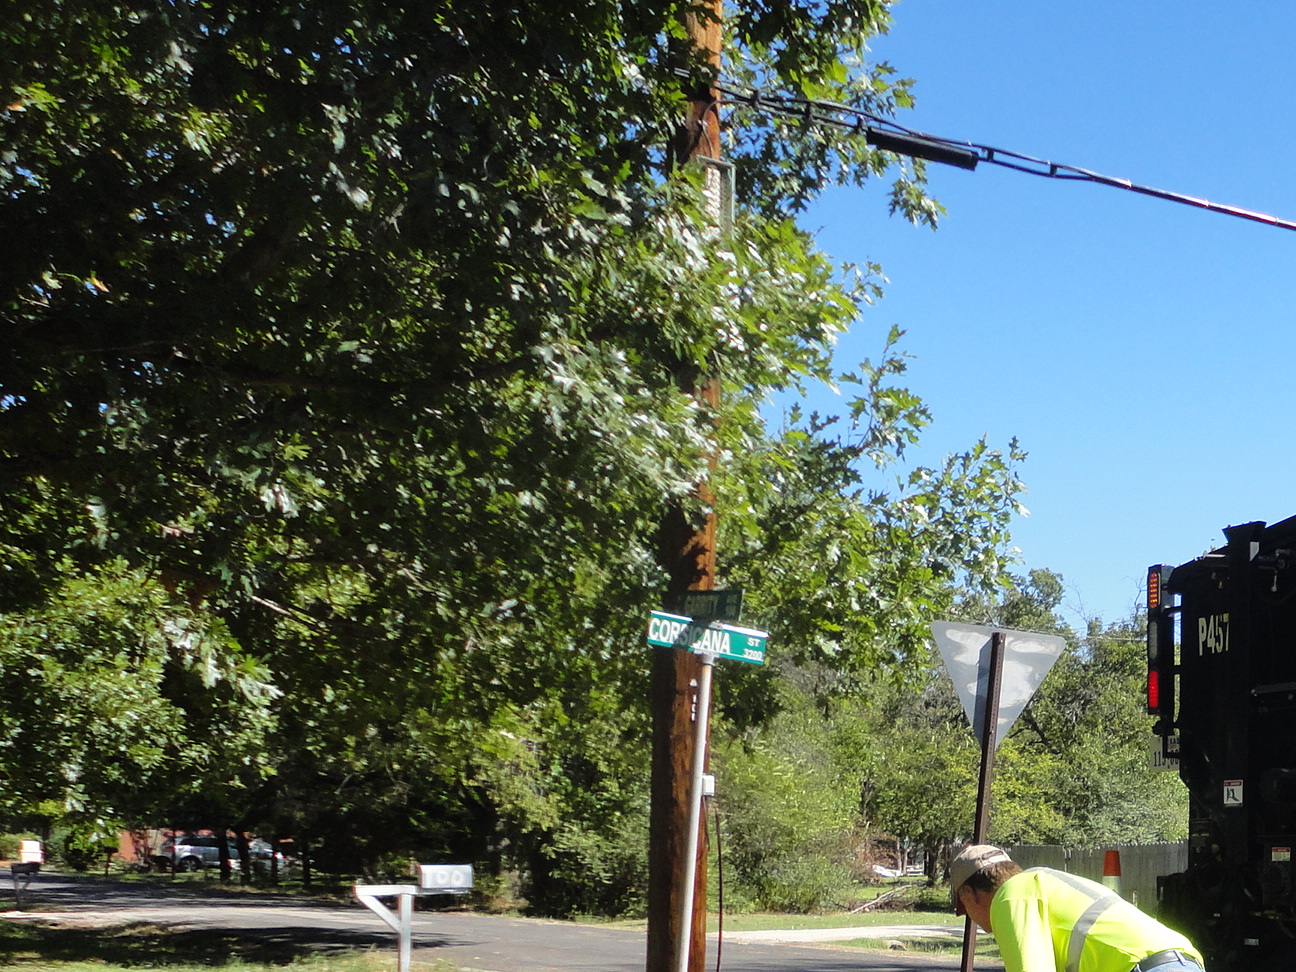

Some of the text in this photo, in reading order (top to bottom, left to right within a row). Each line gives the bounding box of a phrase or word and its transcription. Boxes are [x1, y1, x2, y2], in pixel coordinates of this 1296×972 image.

[649, 617, 761, 655] CORSICANA ST
[1198, 612, 1230, 656] P457
[744, 649, 763, 660] 3200
